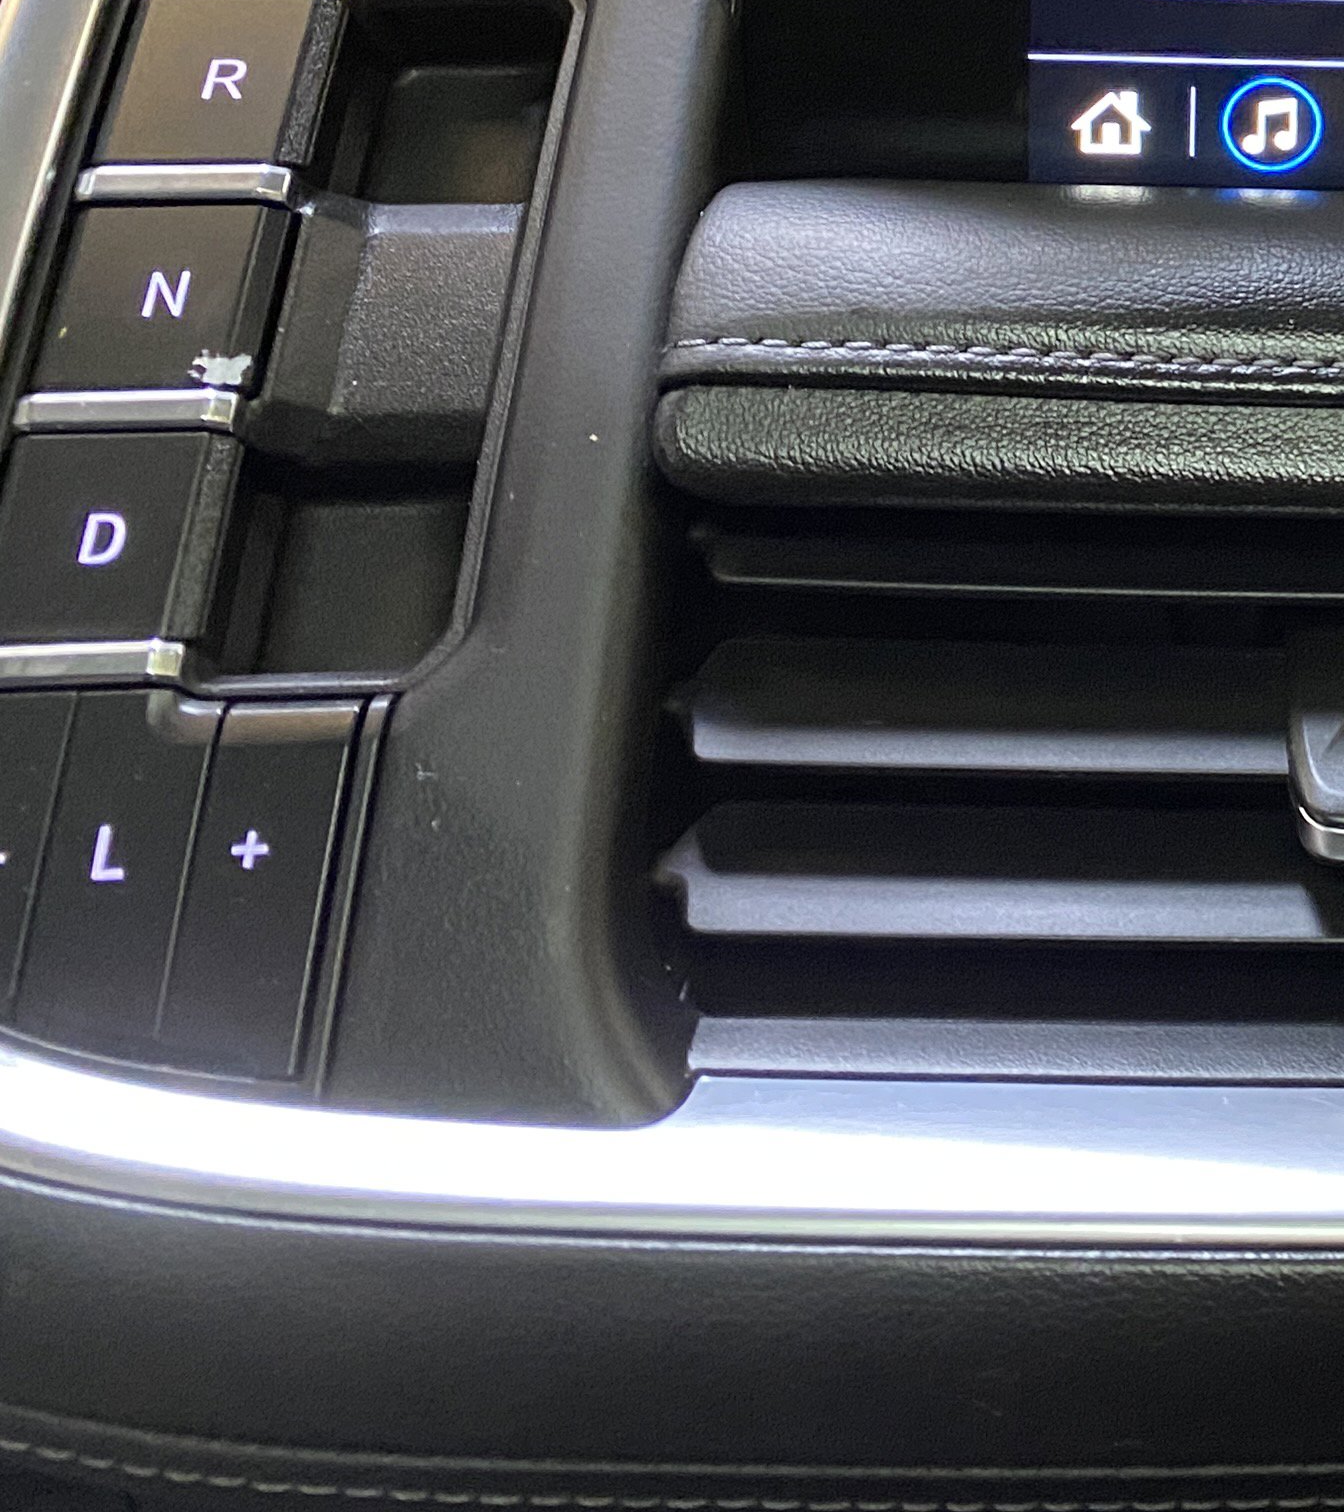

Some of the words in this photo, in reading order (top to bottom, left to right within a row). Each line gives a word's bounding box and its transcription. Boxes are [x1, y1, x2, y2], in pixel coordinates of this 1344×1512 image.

[200, 57, 249, 101] R
[140, 269, 192, 319] N
[76, 511, 128, 568] D
[89, 823, 126, 882] L
